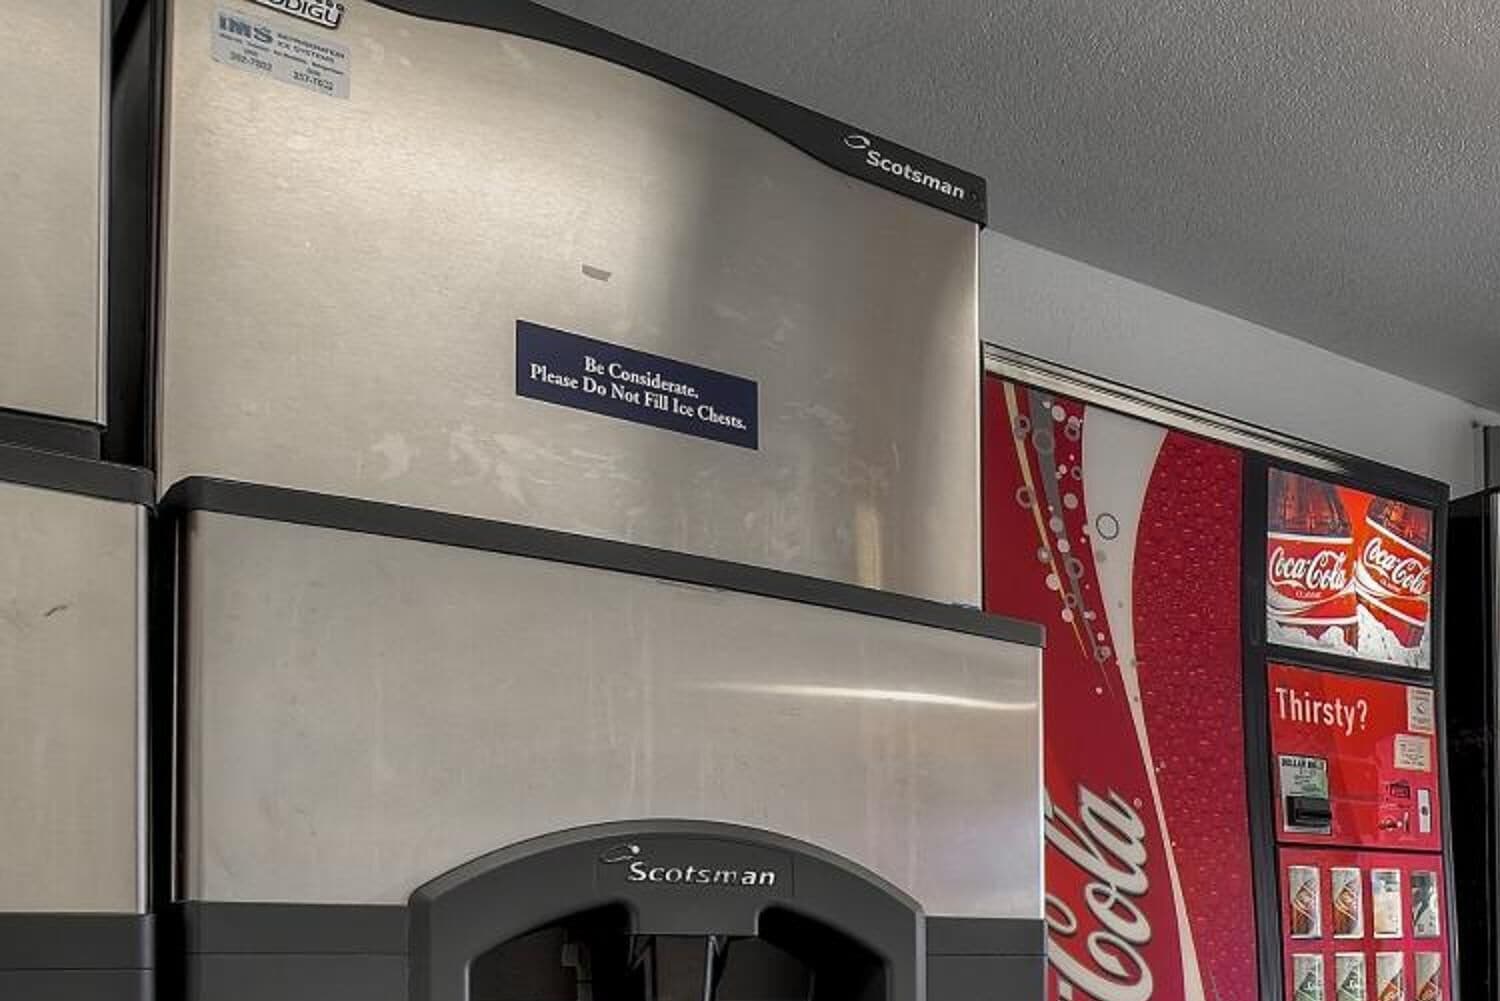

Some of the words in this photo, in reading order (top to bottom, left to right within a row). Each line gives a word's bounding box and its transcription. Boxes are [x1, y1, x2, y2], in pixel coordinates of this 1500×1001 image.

[219, 15, 273, 43] IMS
[866, 150, 965, 199] Scotsman
[529, 363, 578, 390] Please
[582, 376, 608, 396] Do
[611, 383, 640, 405] Not
[644, 391, 669, 412] Fill
[673, 397, 695, 418] Ice
[697, 405, 748, 430] Chests.
[584, 356, 604, 375] Be
[608, 363, 699, 399] Considerate.
[1269, 546, 1346, 590] Coca-Cola
[1275, 687, 1368, 737] Thirsty?
[628, 861, 776, 886] Scotsman
